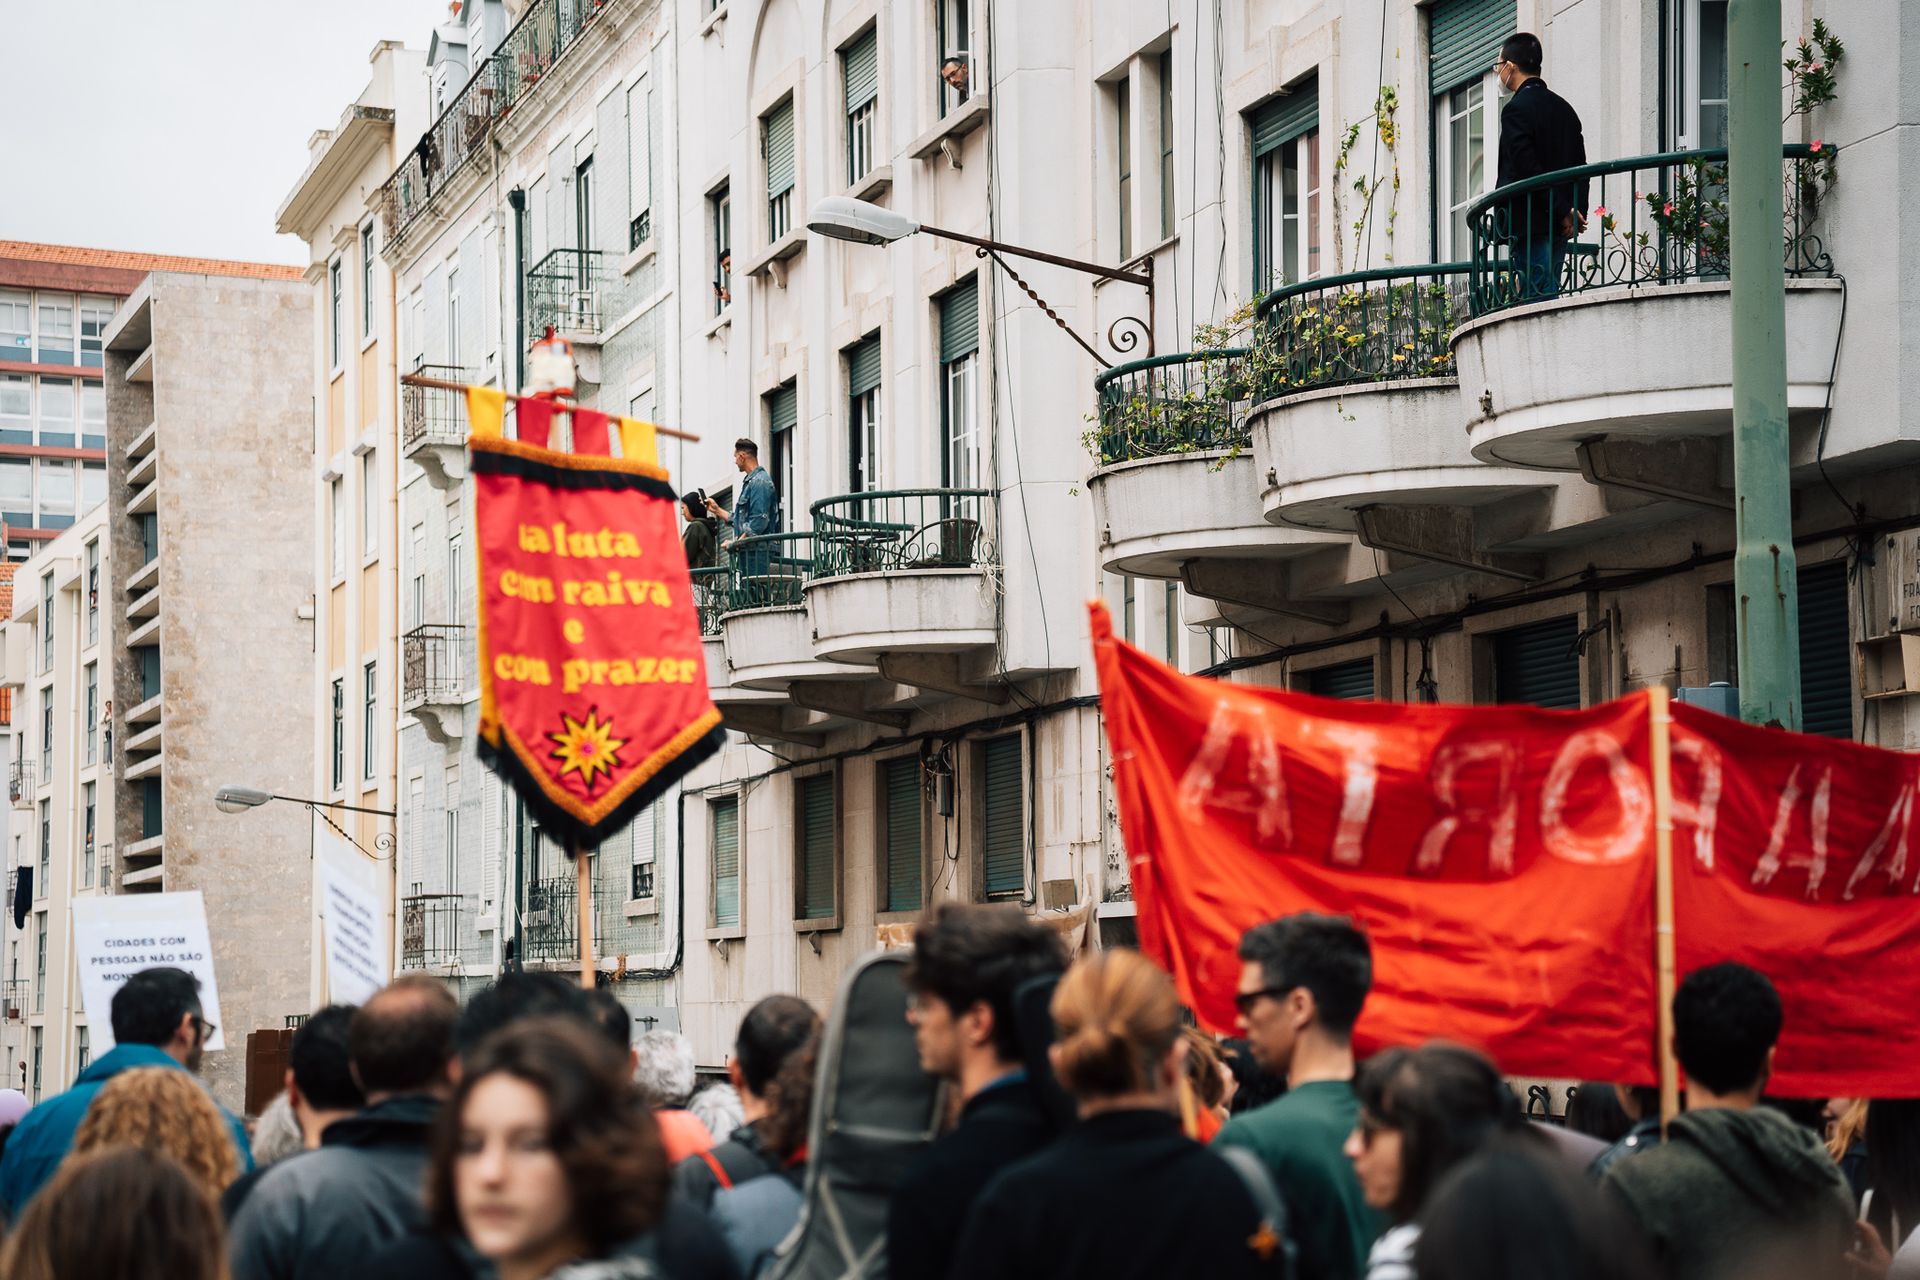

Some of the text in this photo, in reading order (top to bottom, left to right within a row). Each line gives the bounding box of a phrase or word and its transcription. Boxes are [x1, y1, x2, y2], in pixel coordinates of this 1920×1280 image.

[552, 521, 642, 558] luta
[562, 570, 673, 608] raiva
[562, 618, 585, 645] e
[562, 656, 698, 694] prazer
[91, 951, 203, 965] PESSOAS NÃO SÃO
[104, 936, 186, 948] CIDADES COM
